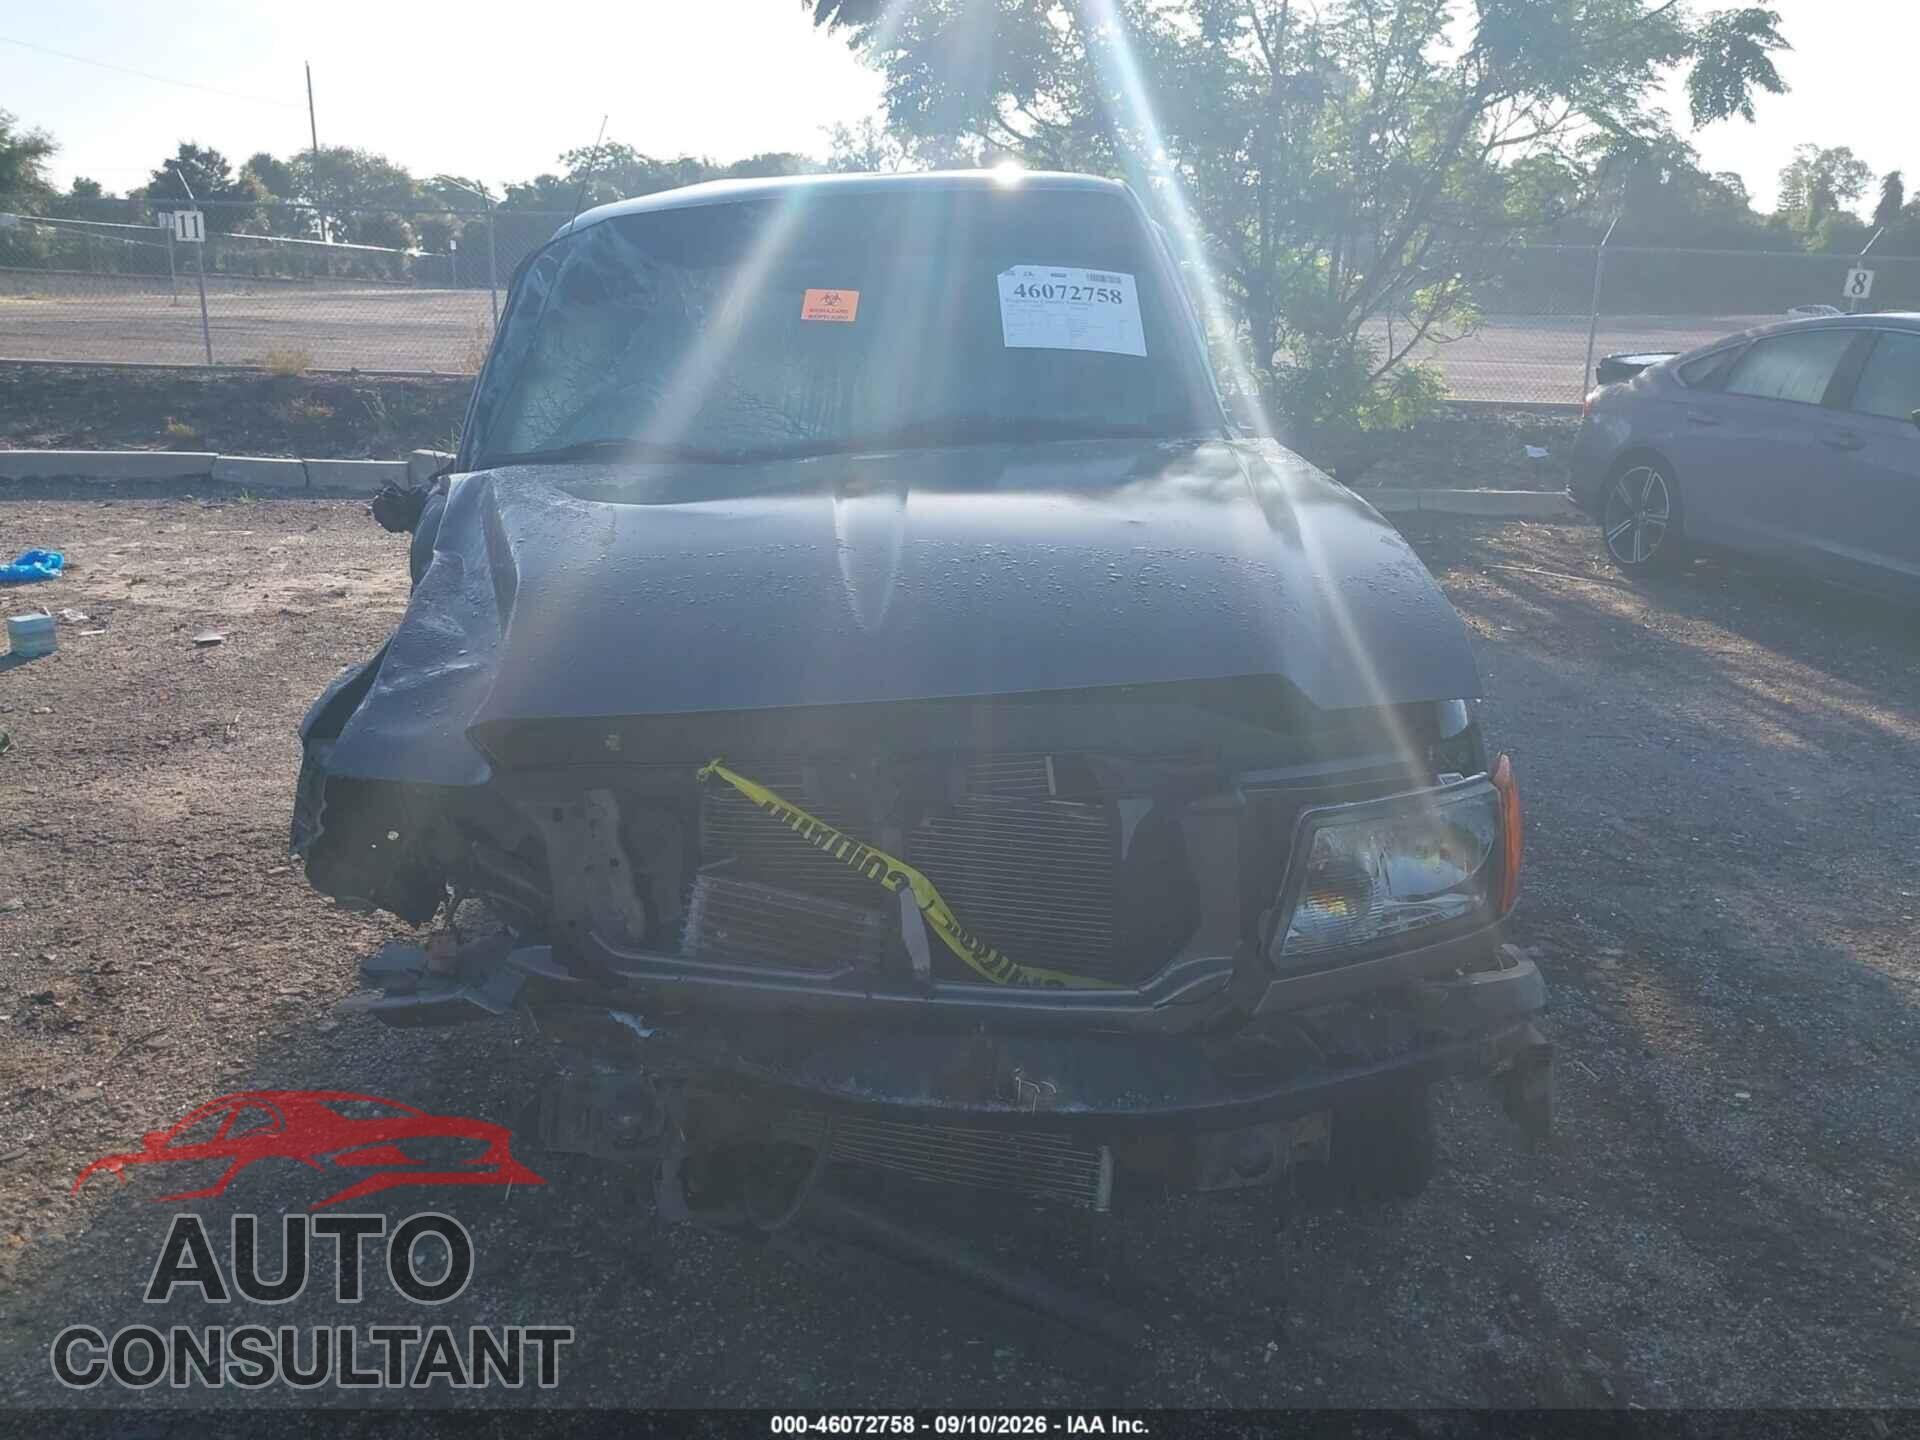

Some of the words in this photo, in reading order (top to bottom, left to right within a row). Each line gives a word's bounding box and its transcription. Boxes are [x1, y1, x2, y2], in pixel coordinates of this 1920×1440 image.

[179, 214, 200, 239] 11
[1013, 283, 1123, 305] 46072758
[1851, 272, 1867, 296] 8
